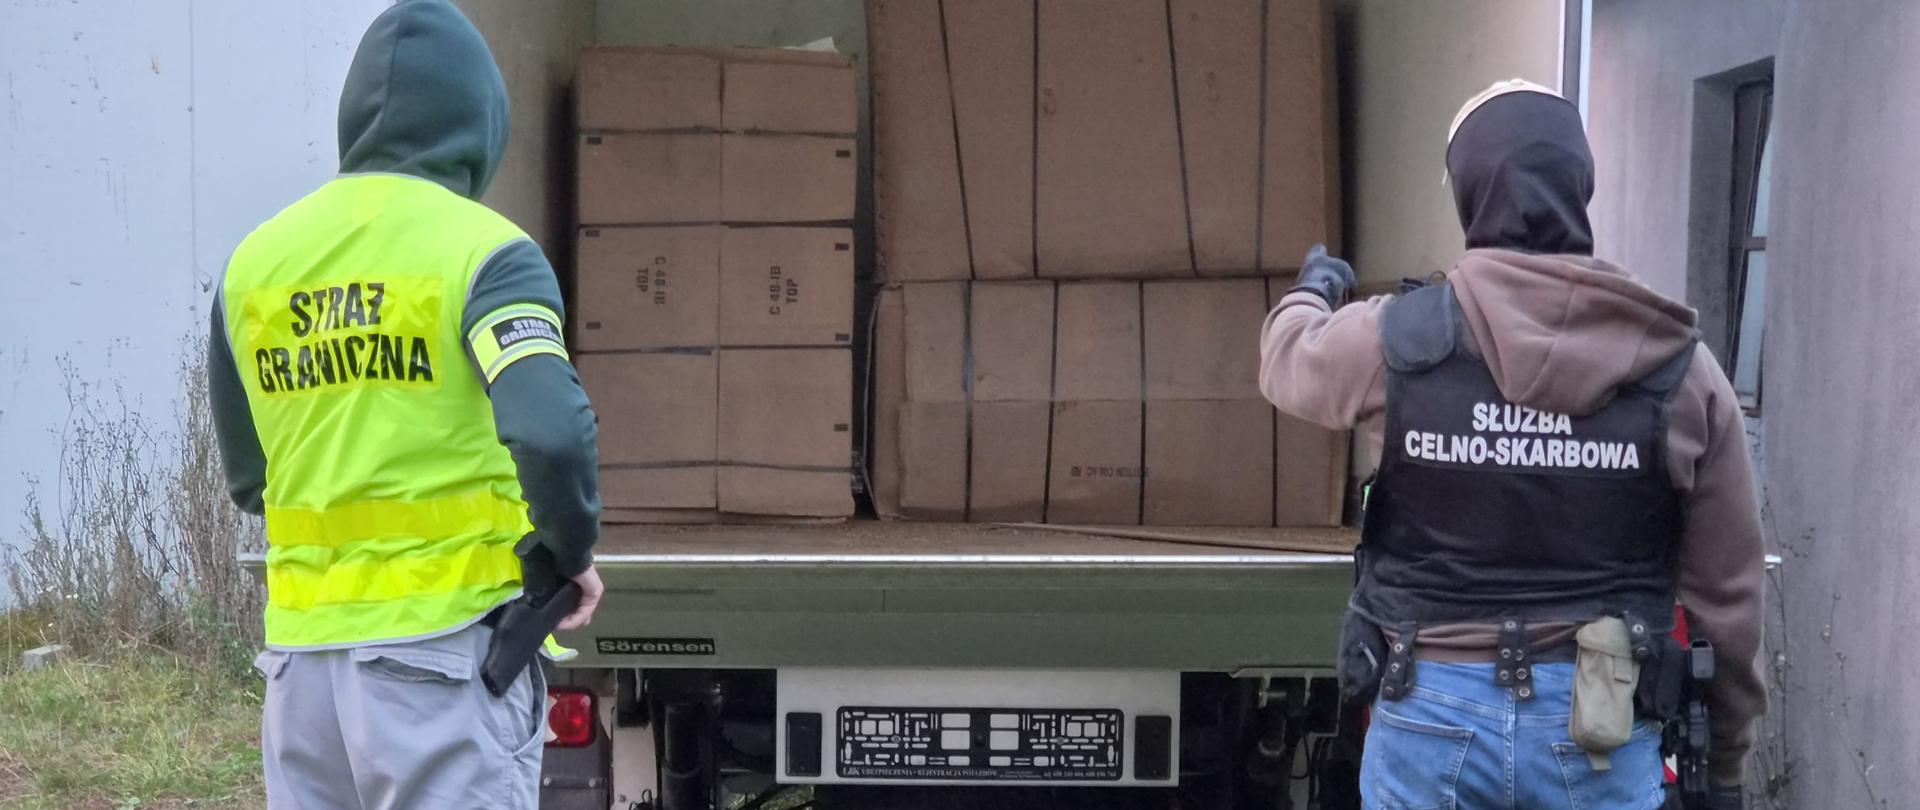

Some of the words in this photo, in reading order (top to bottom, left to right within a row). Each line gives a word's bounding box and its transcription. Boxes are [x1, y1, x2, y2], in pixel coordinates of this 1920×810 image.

[655, 256, 666, 265] C
[636, 268, 649, 293] TOP
[785, 278, 798, 304] TOP
[769, 305, 781, 316] C
[255, 333, 433, 393] GRANICZNA
[1404, 430, 1640, 469] CELNO-SKARBOWA
[599, 641, 713, 652] Sörensen
